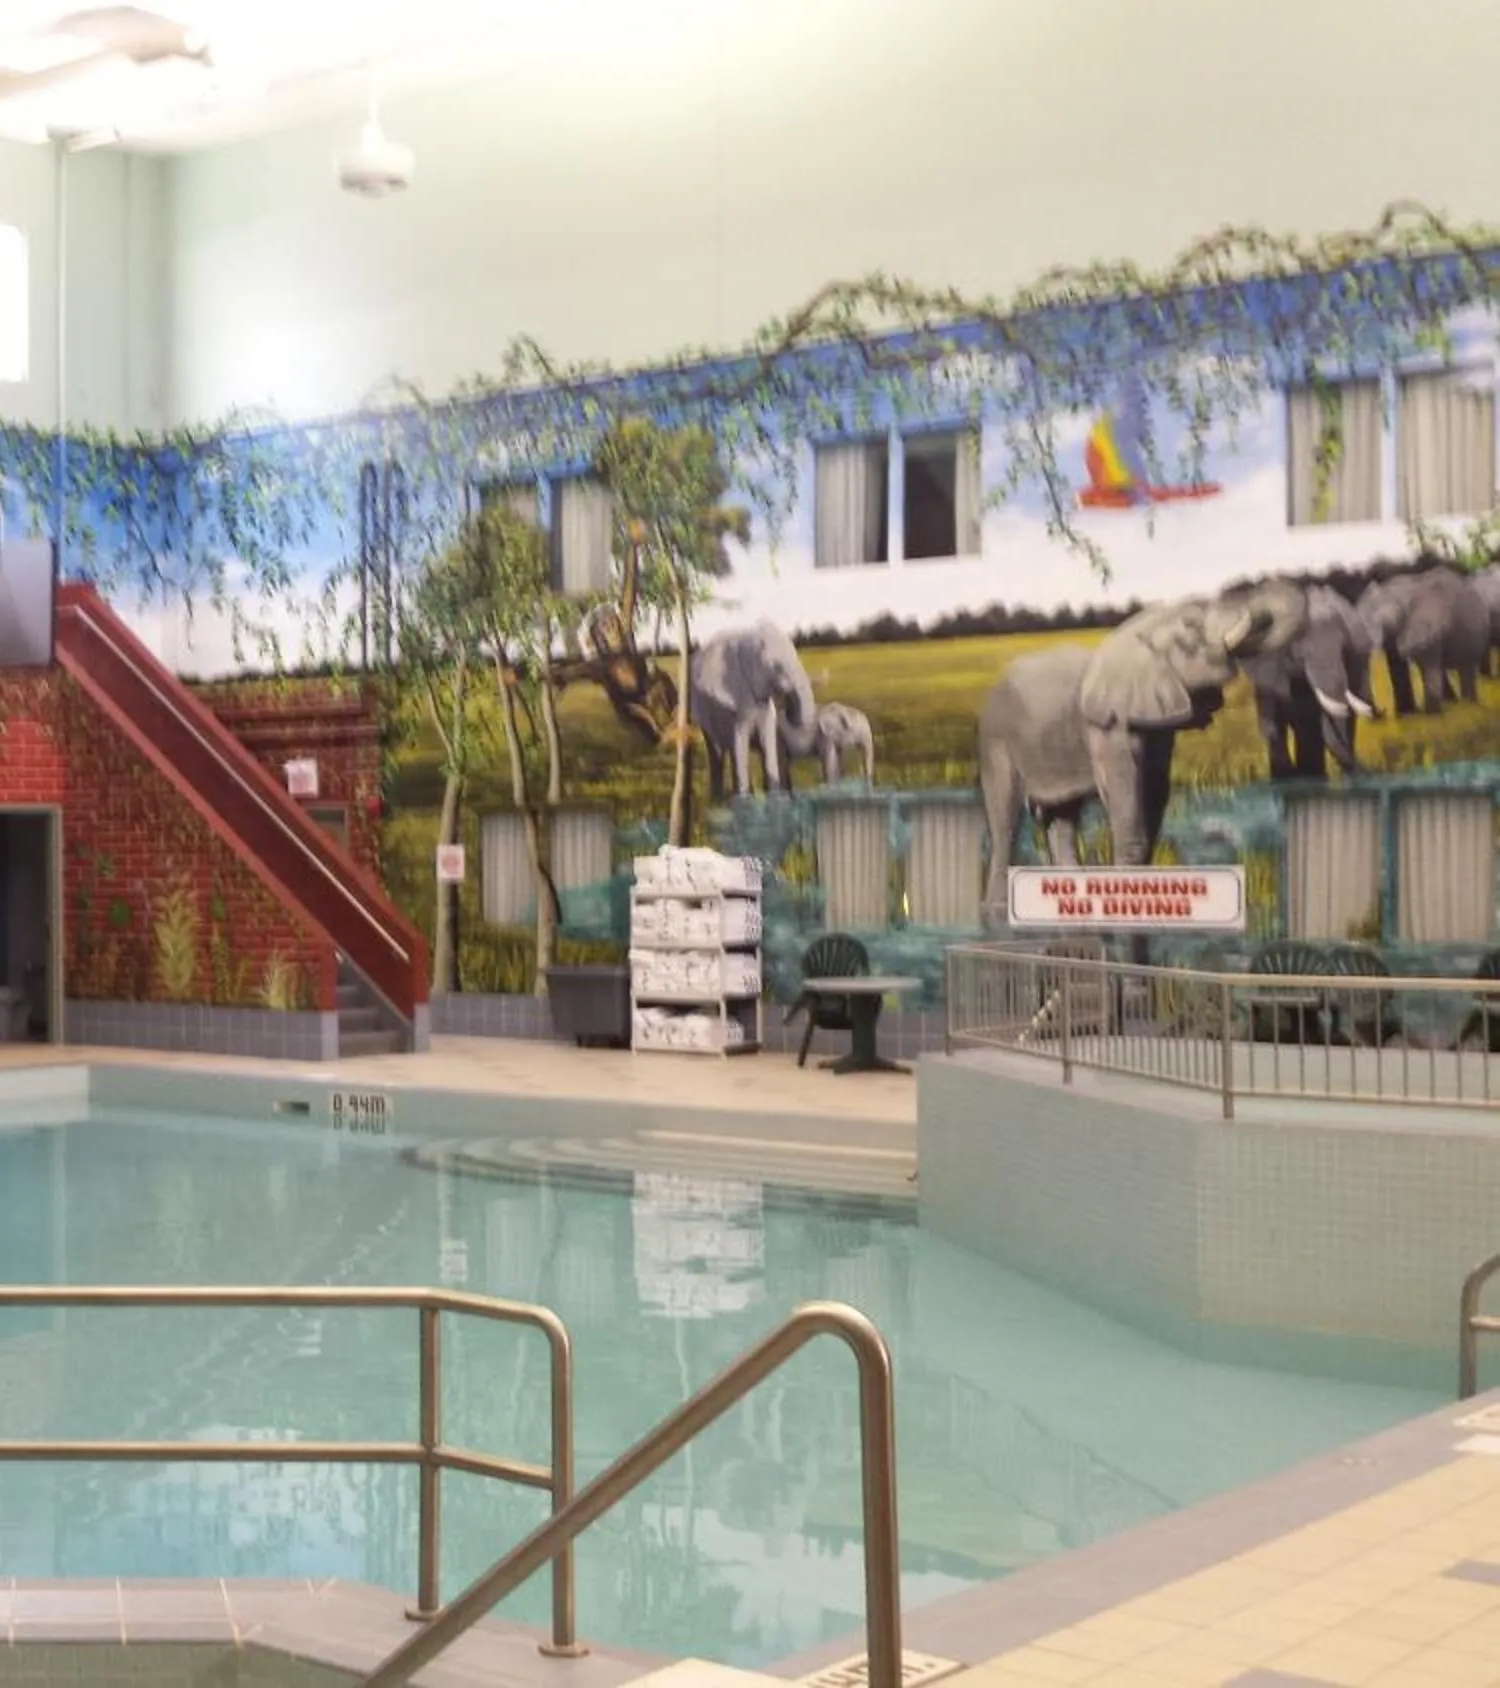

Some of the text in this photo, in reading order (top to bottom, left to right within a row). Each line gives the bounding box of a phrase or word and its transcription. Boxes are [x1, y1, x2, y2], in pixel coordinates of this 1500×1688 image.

[1041, 876, 1208, 896] NO RUNNING
[1058, 897, 1192, 916] NO DIVING
